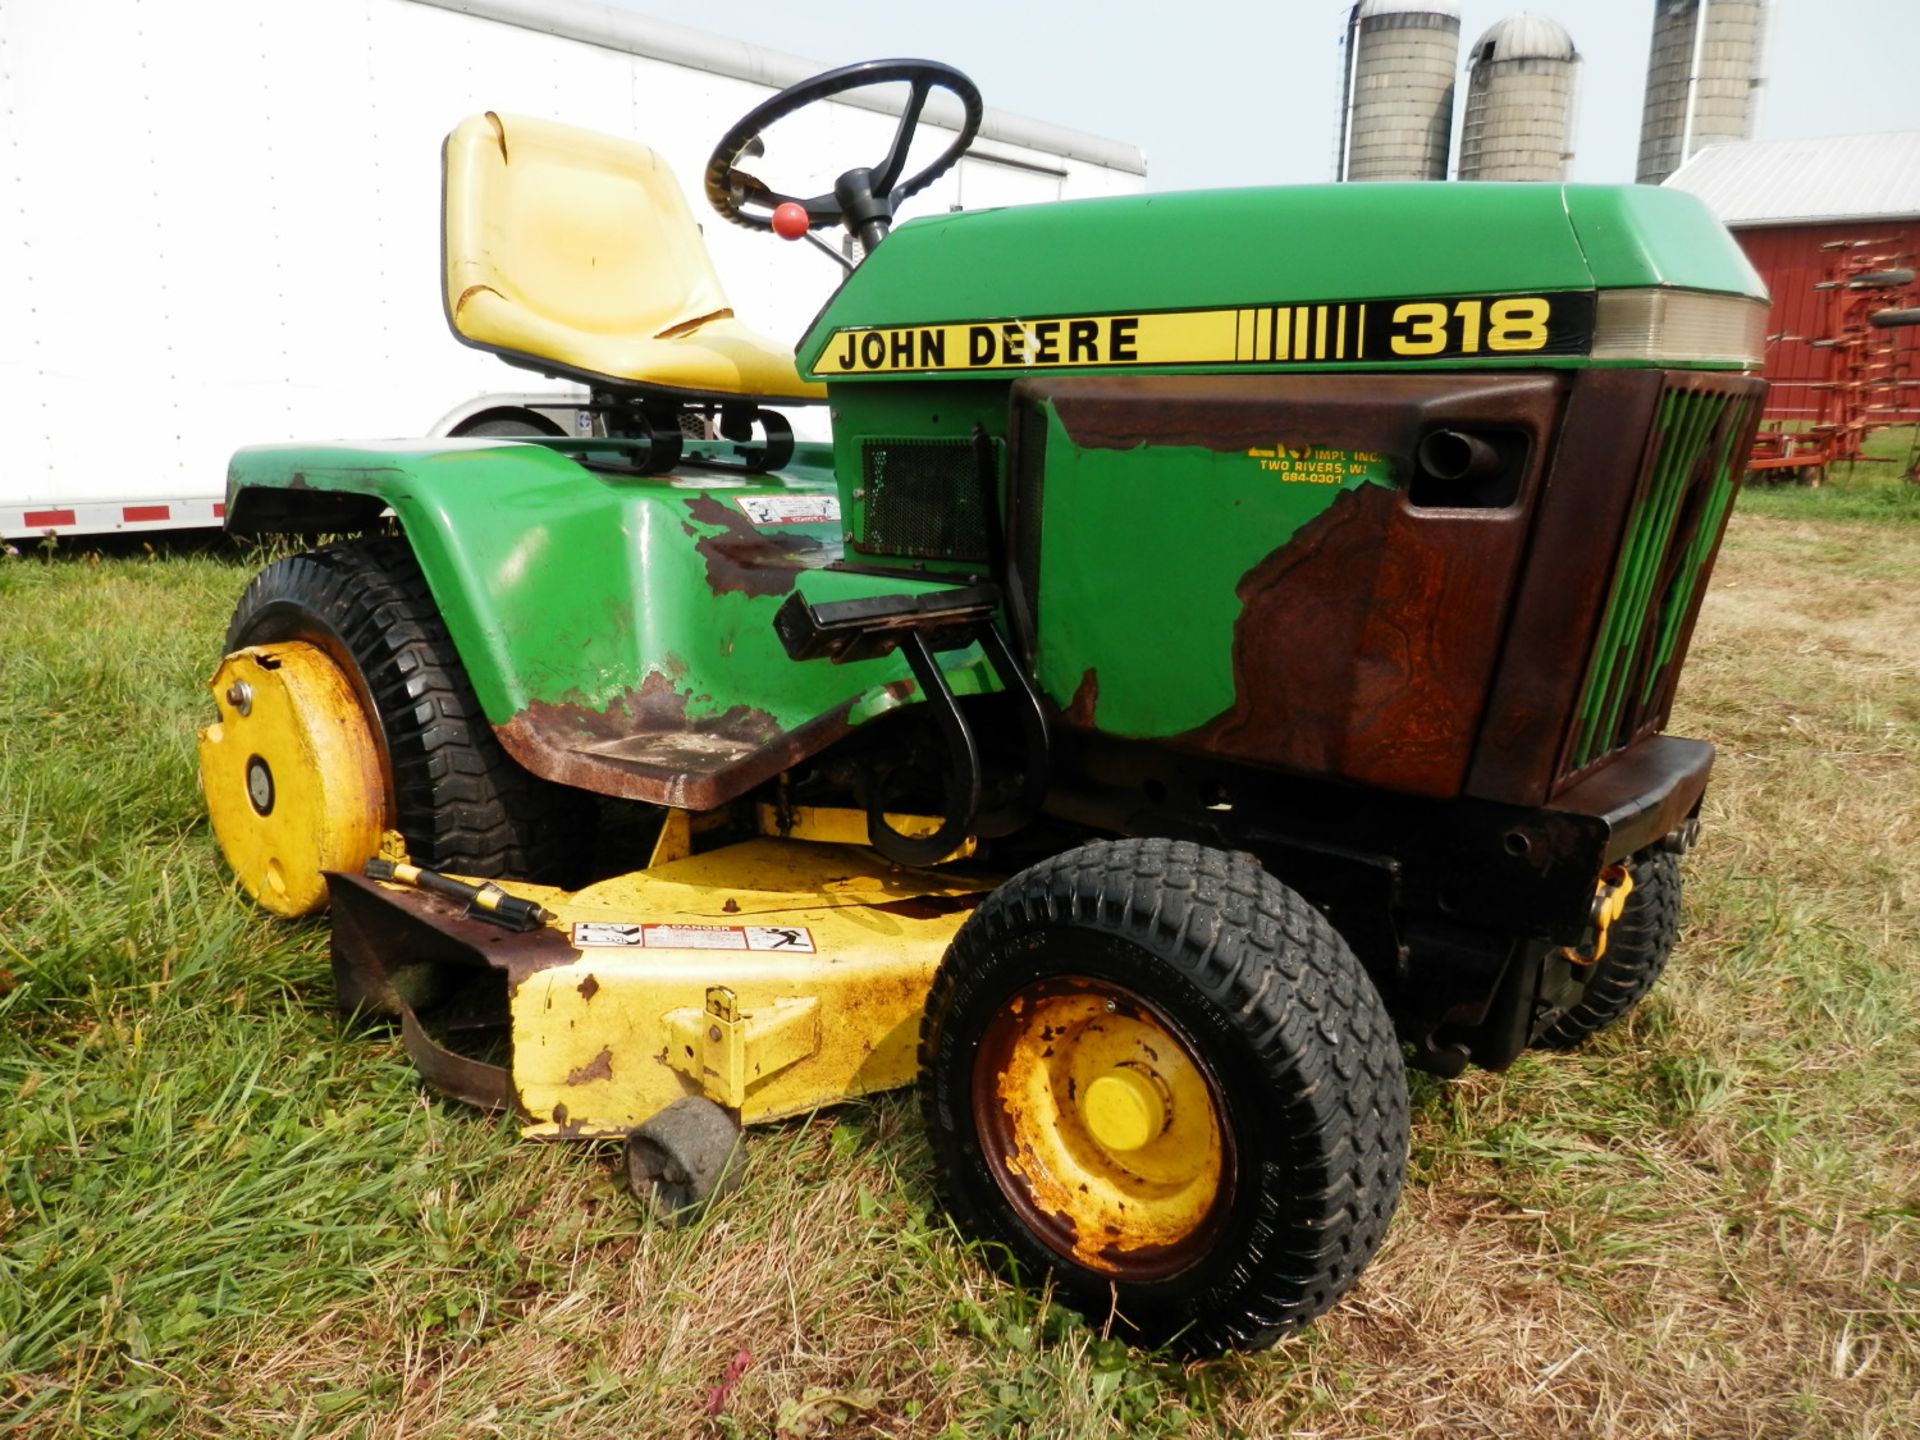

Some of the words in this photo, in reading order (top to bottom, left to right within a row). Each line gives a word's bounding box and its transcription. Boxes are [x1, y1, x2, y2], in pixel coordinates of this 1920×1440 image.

[1390, 298, 1551, 355] 318
[839, 329, 946, 370] JOHN
[969, 318, 1139, 366] DEERE
[1260, 460, 1289, 470] TWO
[1294, 461, 1346, 474] RIVERS,
[1281, 472, 1342, 484] 684-0301
[671, 924, 731, 932] DANGER
